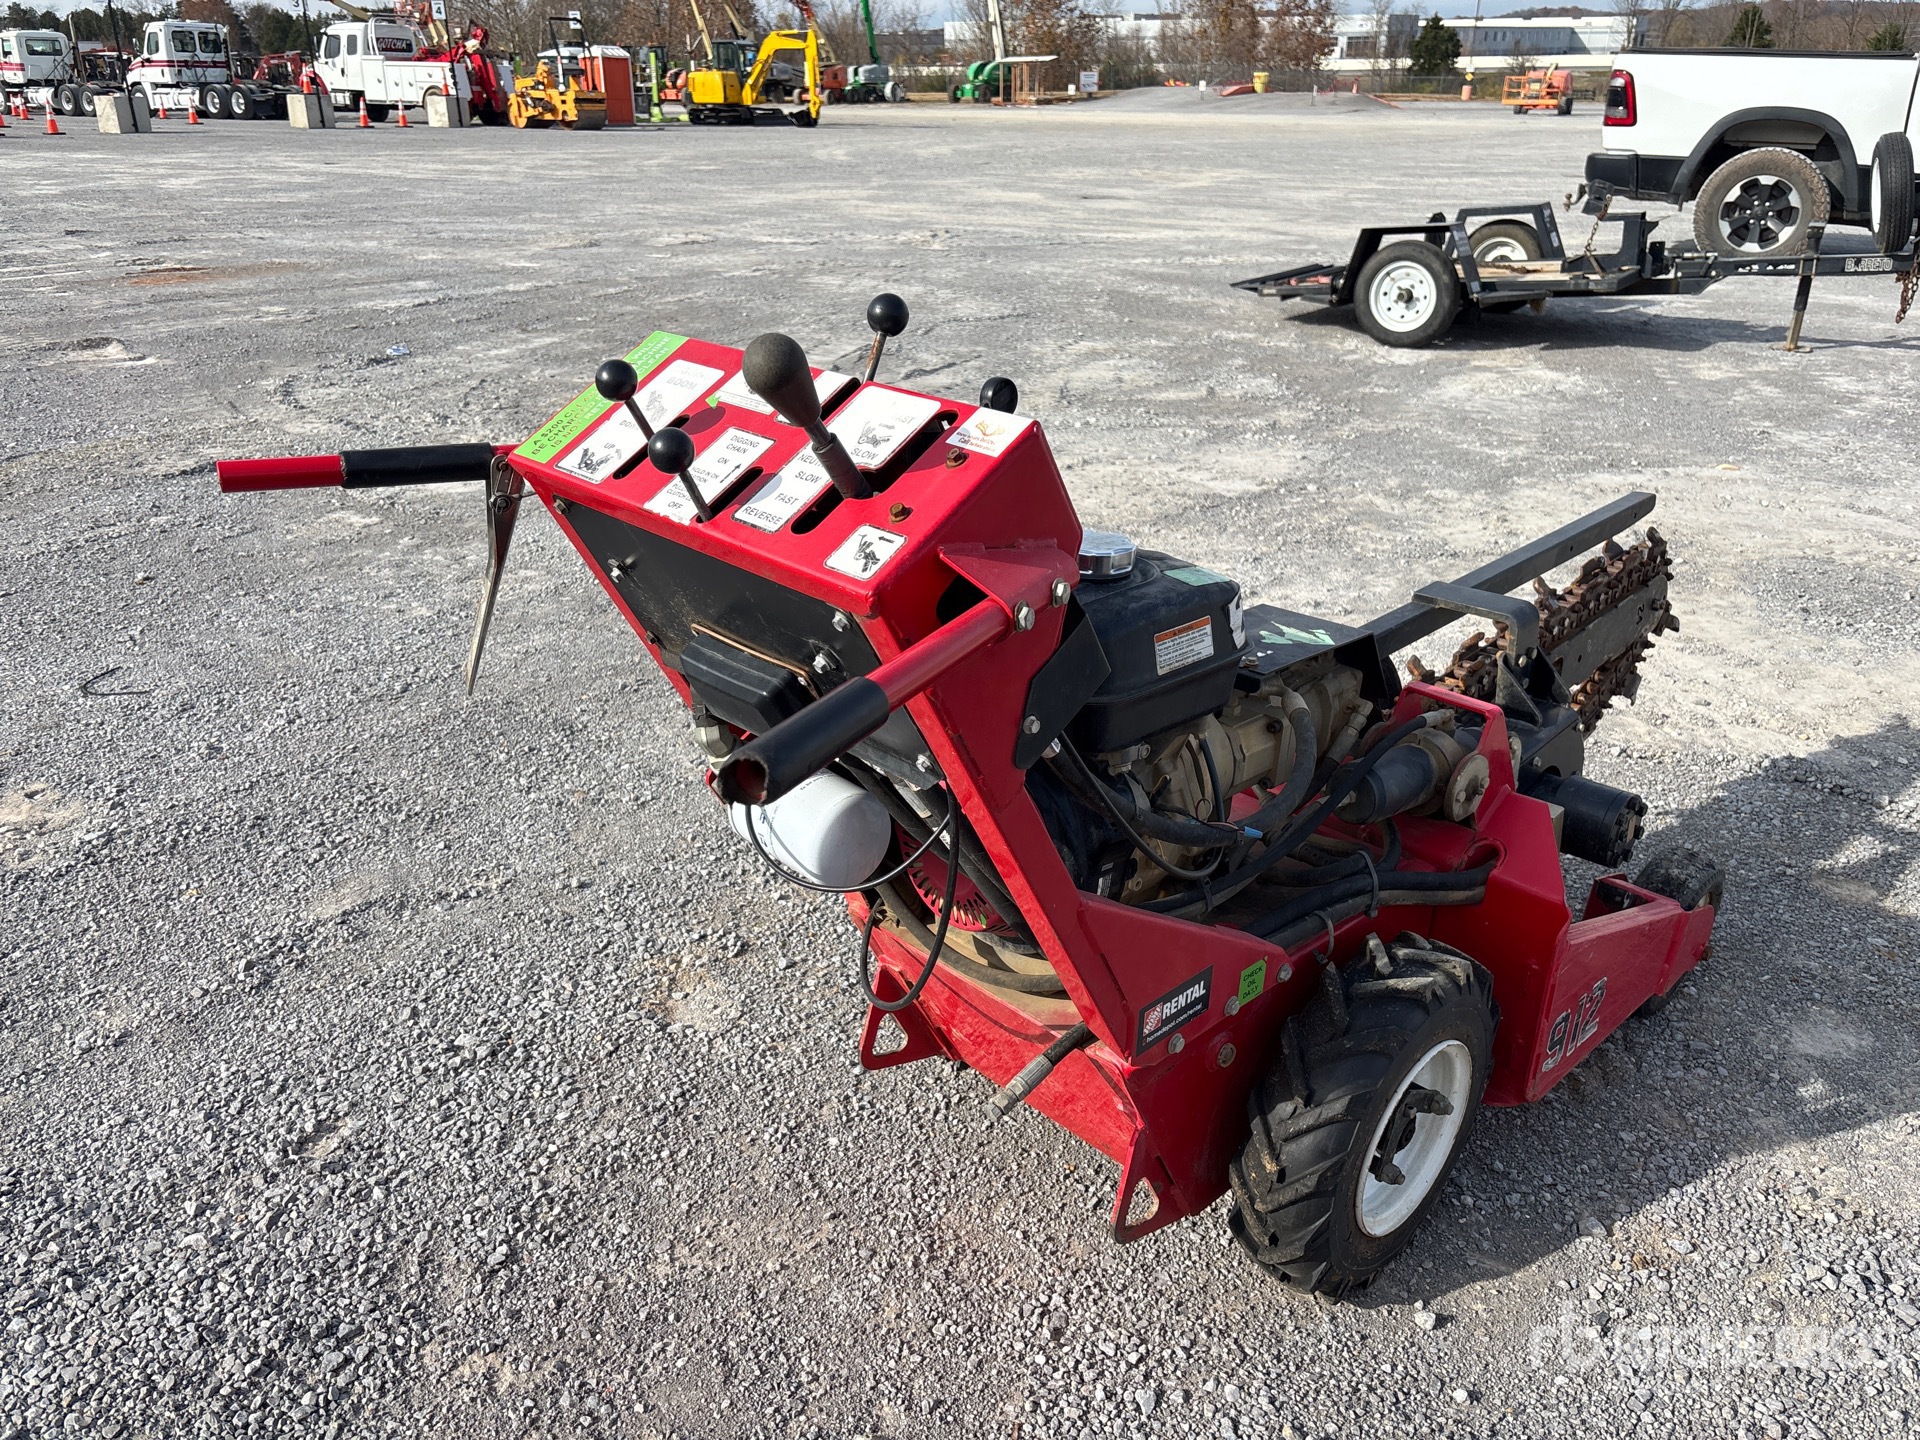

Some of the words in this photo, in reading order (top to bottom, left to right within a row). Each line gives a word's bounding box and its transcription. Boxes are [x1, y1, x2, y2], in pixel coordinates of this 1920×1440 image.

[378, 38, 406, 50] GOTCHA
[541, 420, 564, 438] $200
[632, 341, 656, 360] WILL
[666, 377, 698, 391] BOOM
[551, 438, 562, 448] IS
[563, 421, 582, 438] NOT
[730, 434, 760, 448] DIGGING
[532, 442, 548, 456] BE
[726, 444, 748, 454] CHAIN
[850, 447, 879, 460] SLOW
[717, 457, 730, 465] ON
[795, 470, 822, 484] SLOW
[668, 501, 683, 510] OFF
[775, 493, 799, 506] FAST
[742, 506, 784, 525] REVERSE
[1243, 965, 1263, 982] CHECK
[1248, 978, 1256, 988] OIL
[1162, 980, 1206, 1020] RENTAL
[1146, 1002, 1203, 1044] homedepot.com/rental
[1542, 976, 1608, 1073] 912
